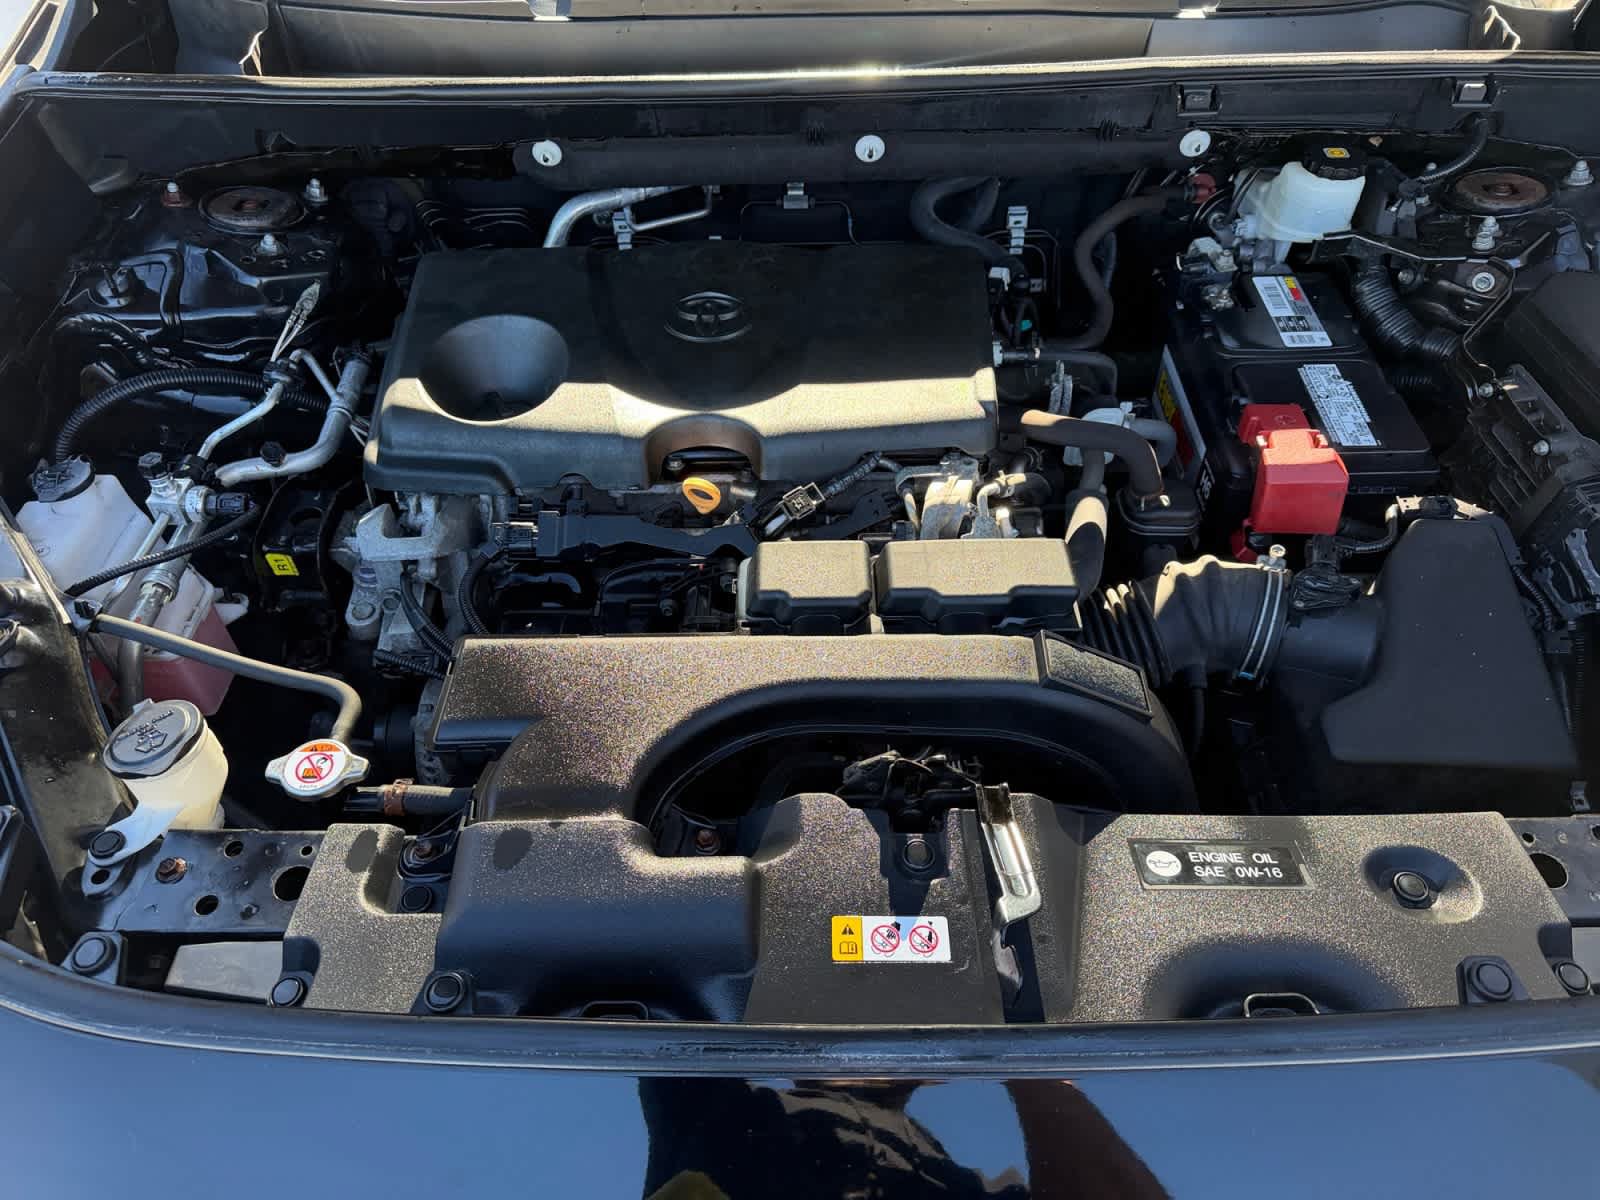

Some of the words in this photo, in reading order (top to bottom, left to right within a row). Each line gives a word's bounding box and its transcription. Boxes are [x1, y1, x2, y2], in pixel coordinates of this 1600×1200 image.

[1188, 851, 1245, 864] ENGINE
[1252, 853, 1279, 864] OIL
[1194, 866, 1226, 877] SAE
[1235, 867, 1283, 878] 0W-16
